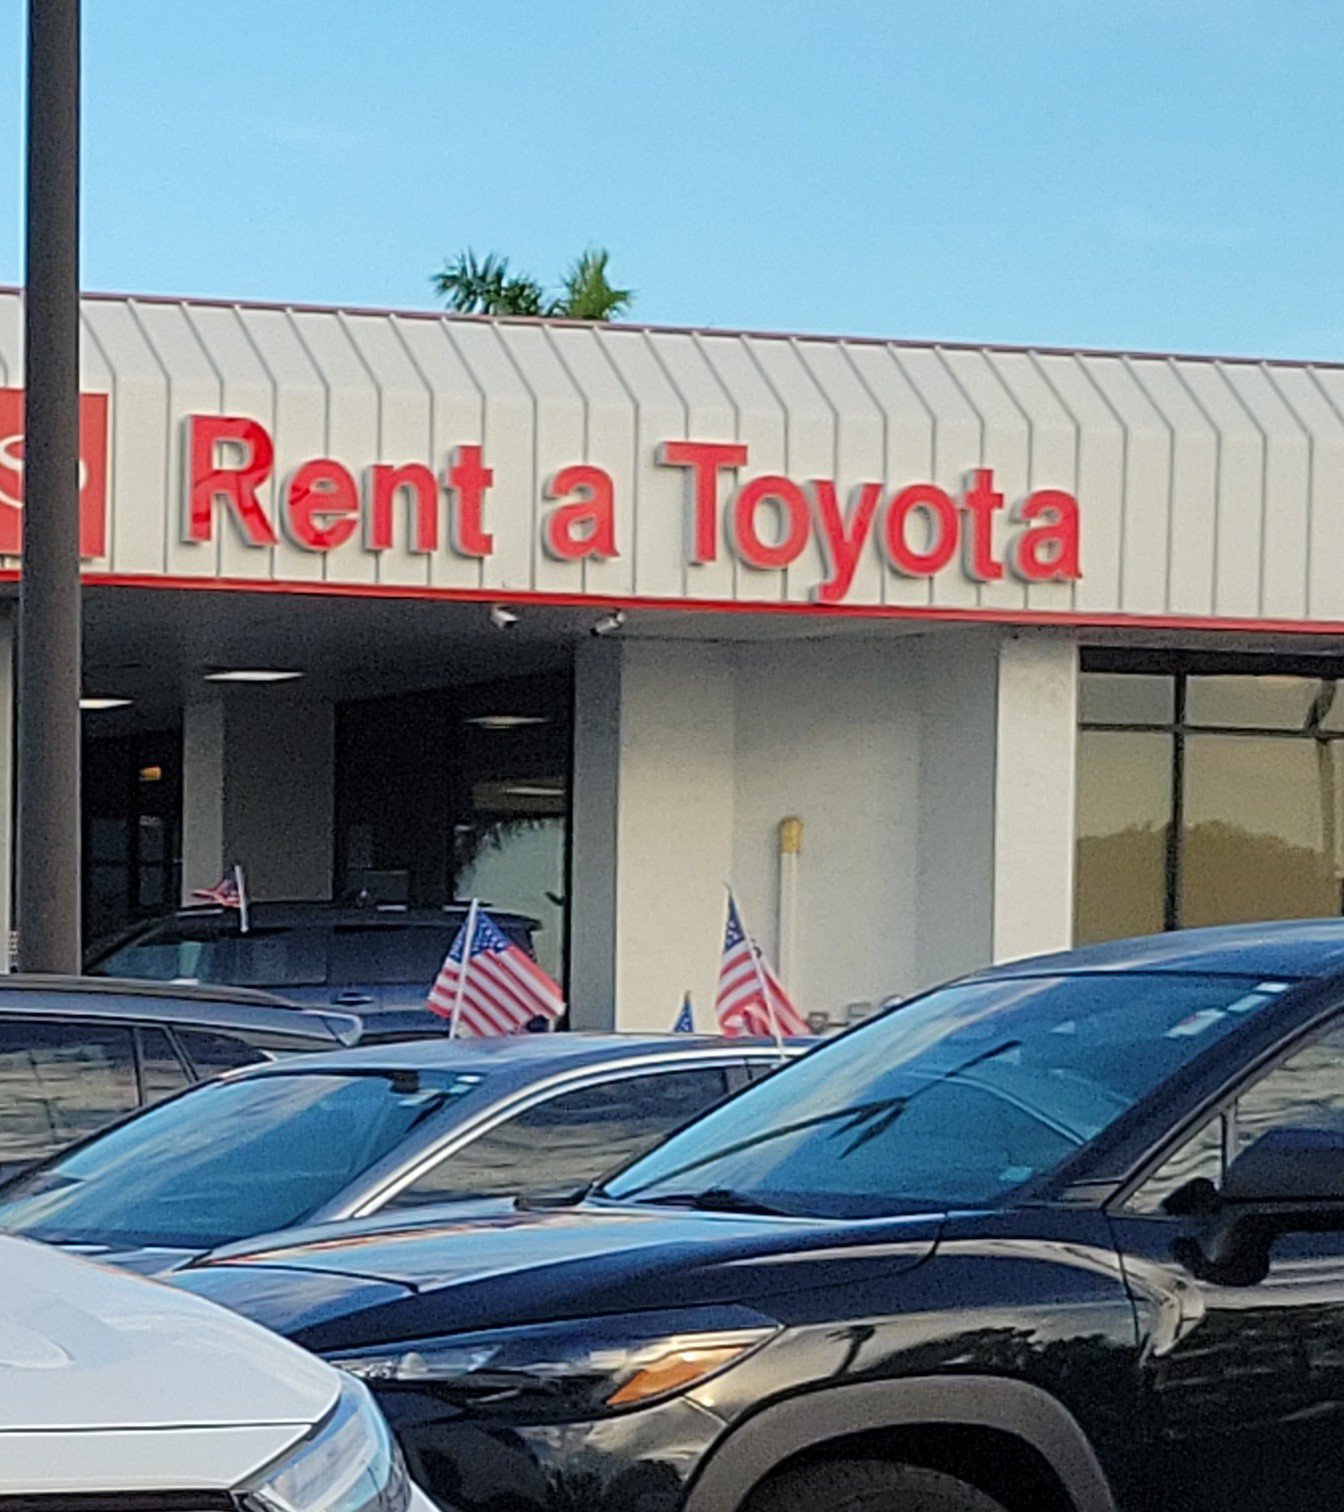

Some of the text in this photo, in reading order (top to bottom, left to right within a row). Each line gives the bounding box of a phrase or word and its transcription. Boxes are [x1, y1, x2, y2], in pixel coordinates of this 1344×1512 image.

[180, 413, 1083, 604] Rent a Toyota
